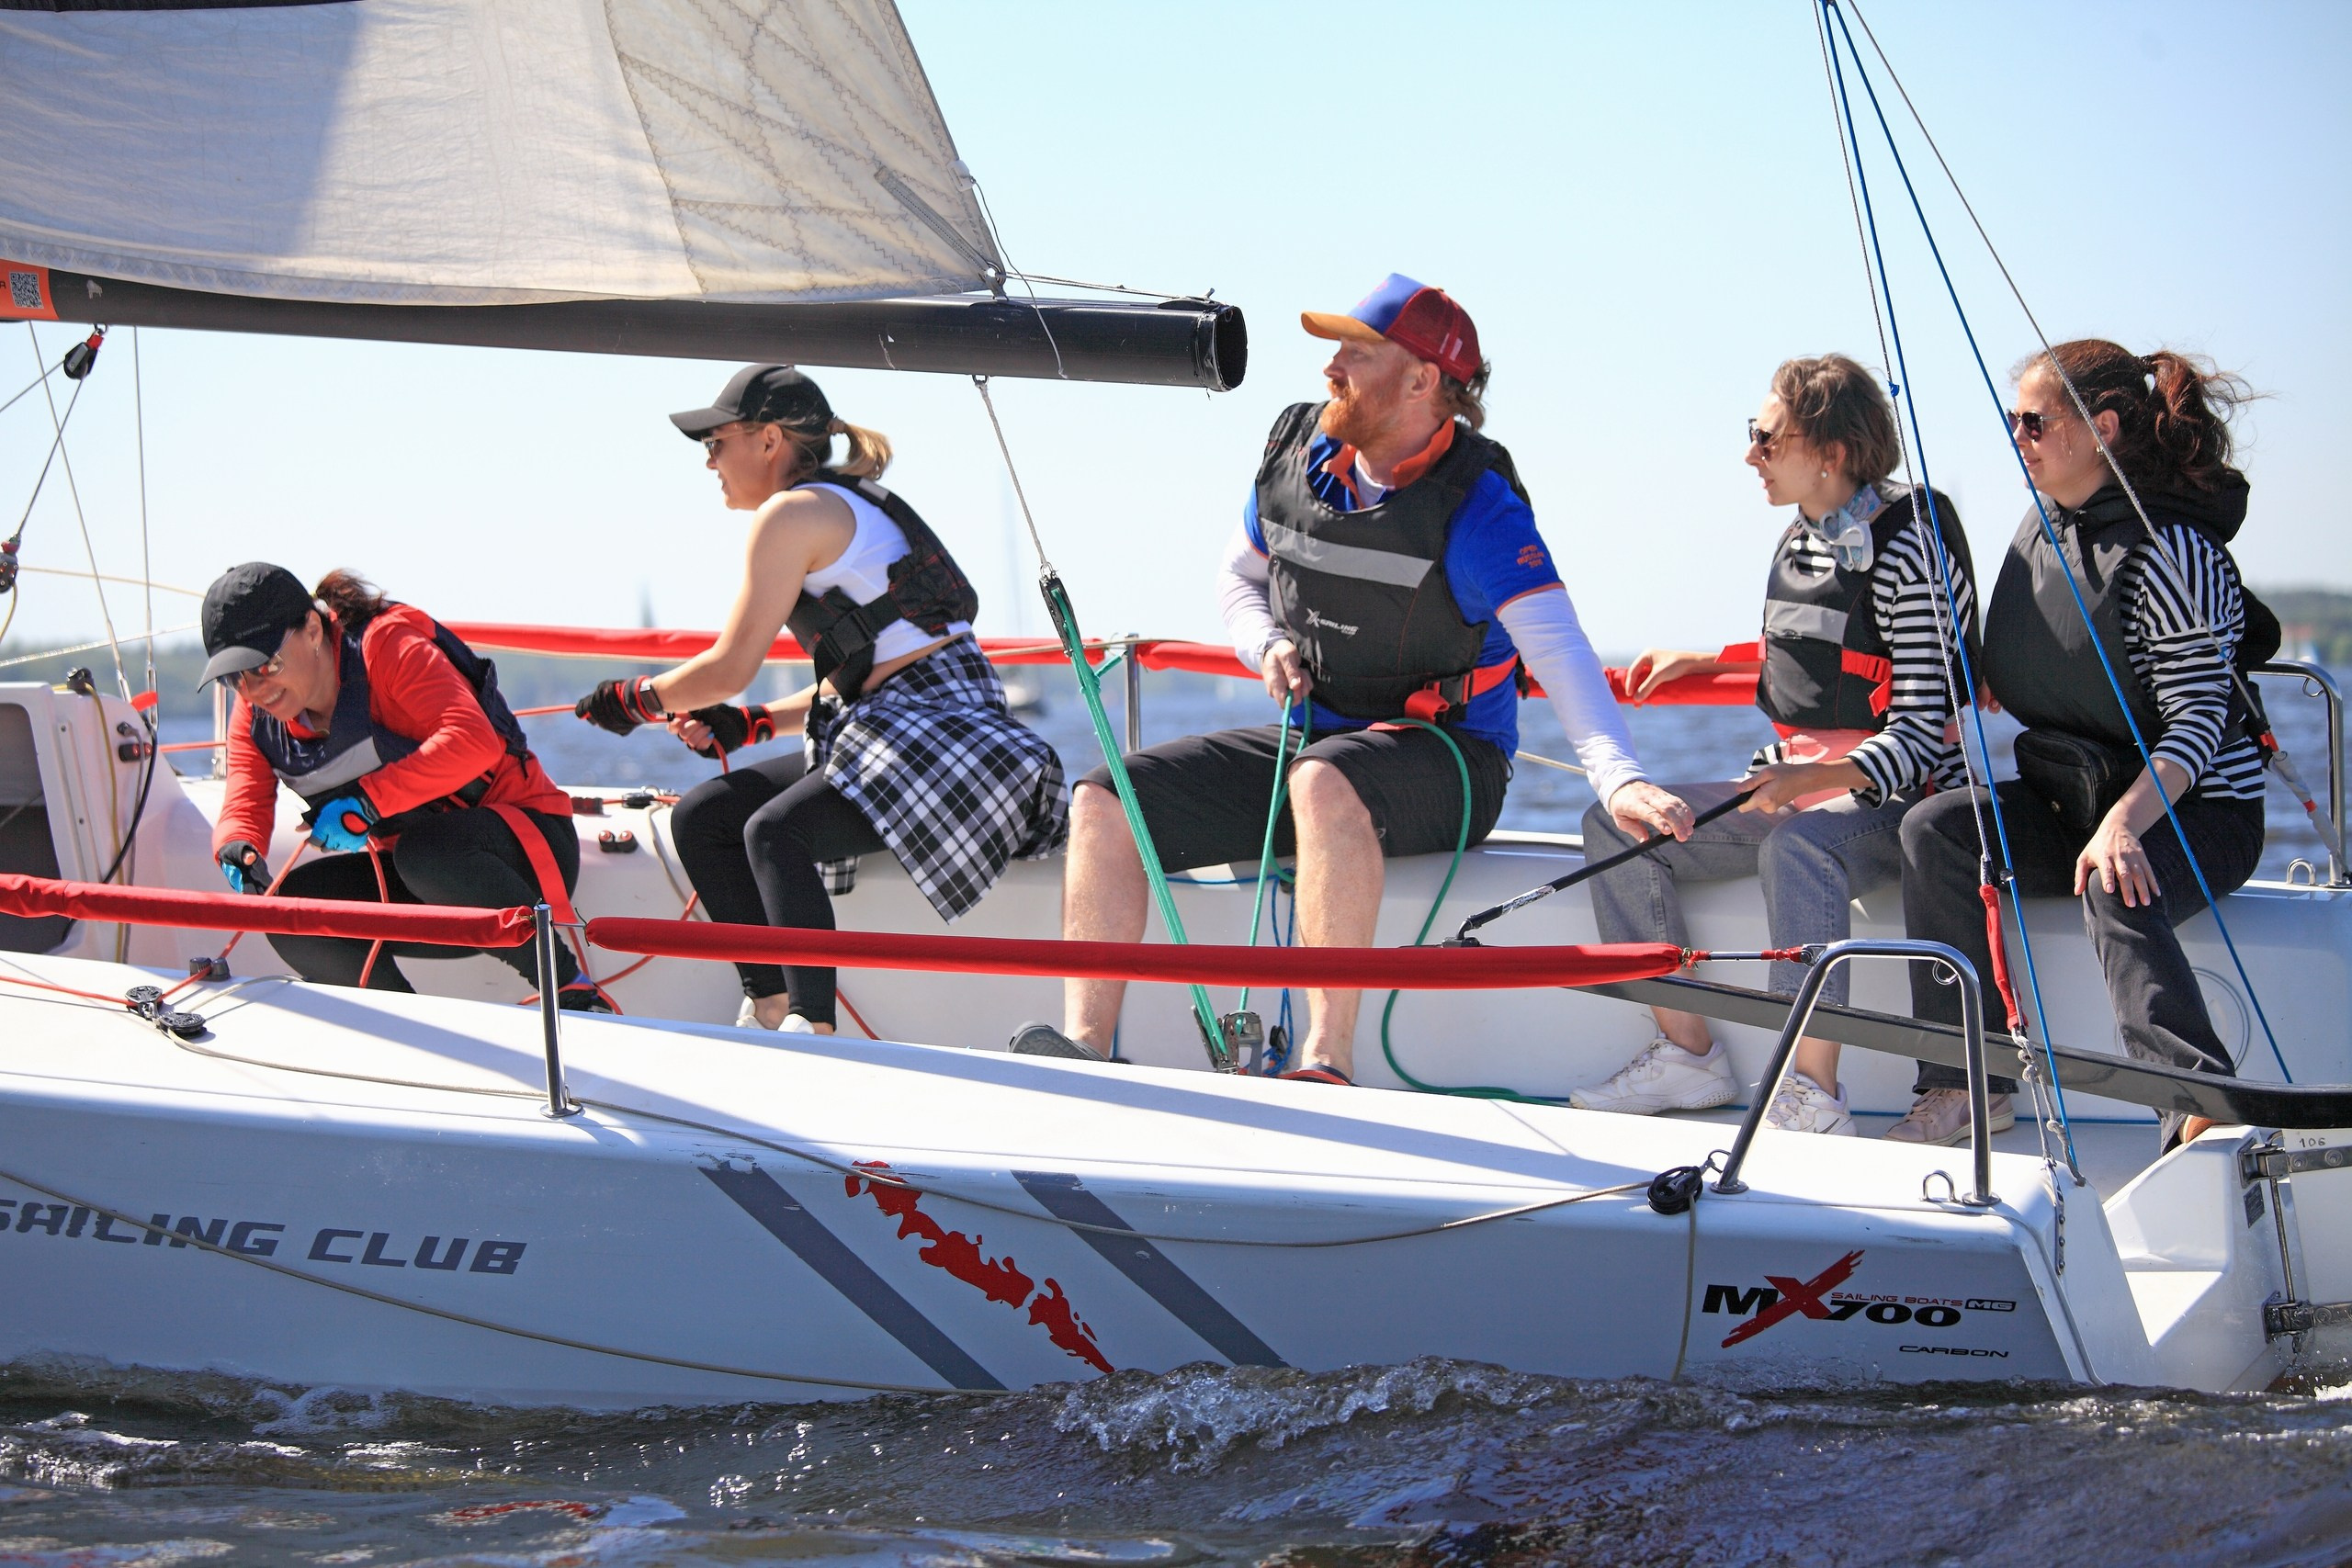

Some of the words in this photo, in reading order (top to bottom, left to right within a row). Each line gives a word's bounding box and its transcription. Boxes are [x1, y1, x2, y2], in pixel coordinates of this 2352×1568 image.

[2299, 1137, 2326, 1147] 106
[307, 1228, 526, 1274] CLUB
[1831, 1292, 1898, 1303] SAILING
[1905, 1296, 1963, 1306] BOATS
[1966, 1299, 2016, 1311] MG
[1899, 1345, 2009, 1358] CARBON
